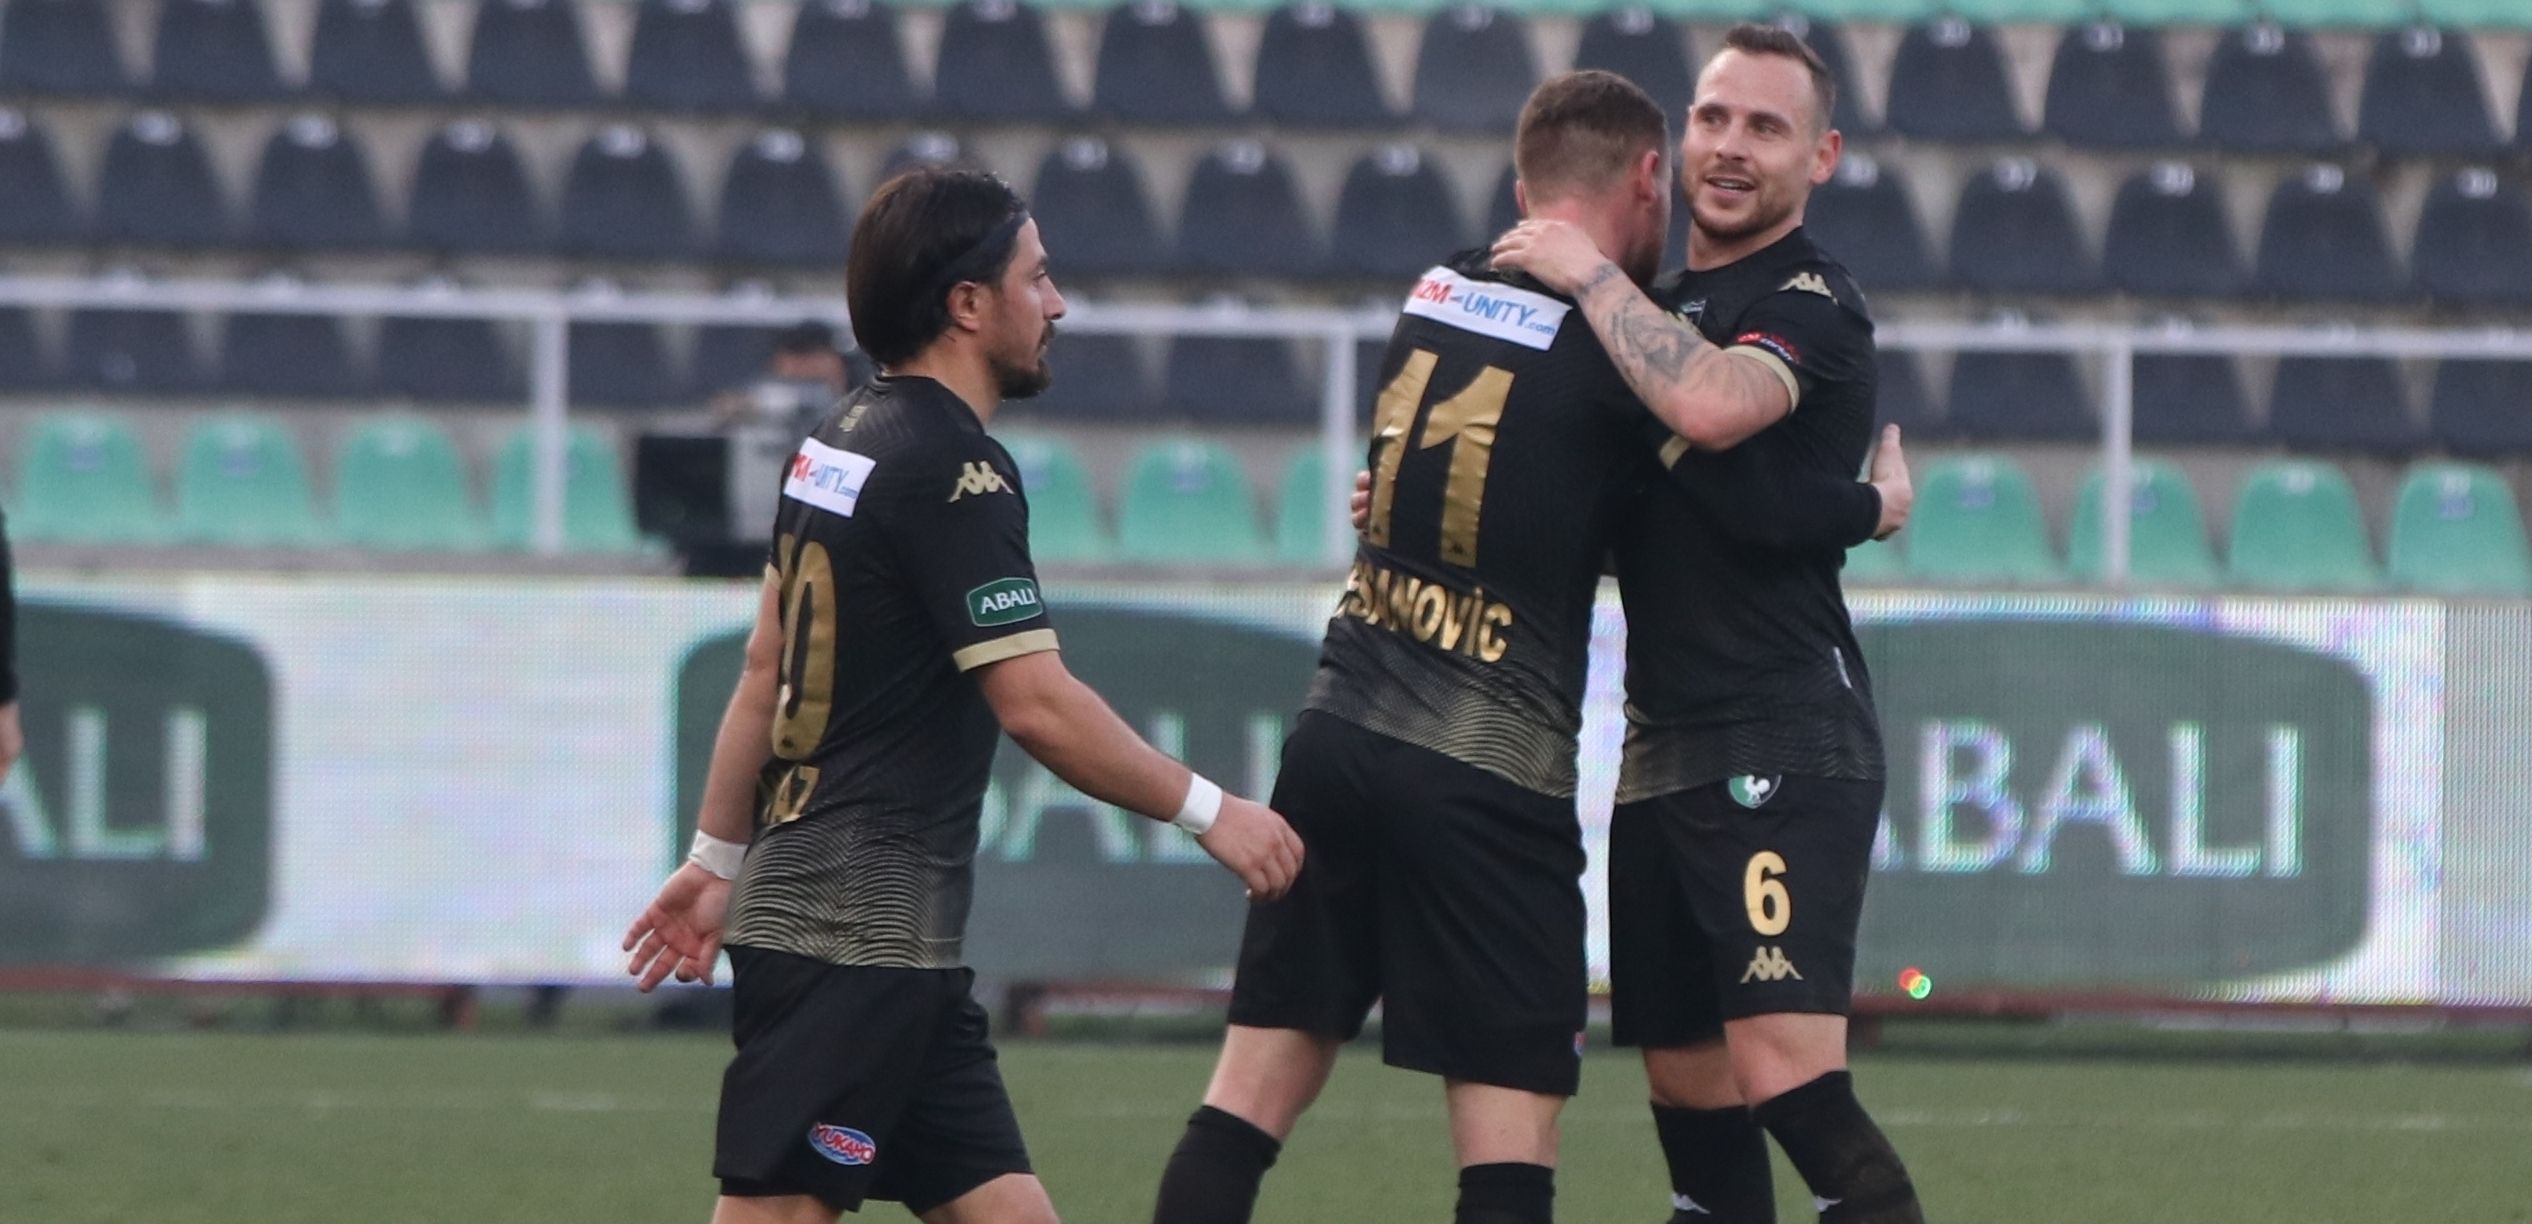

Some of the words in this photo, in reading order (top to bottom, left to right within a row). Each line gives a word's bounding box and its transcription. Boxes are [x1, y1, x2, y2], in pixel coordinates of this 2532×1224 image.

[1369, 348, 1516, 568] 11
[980, 587, 1037, 615] ABALI
[1871, 717, 2303, 877] BALI
[1744, 850, 1792, 937] 6
